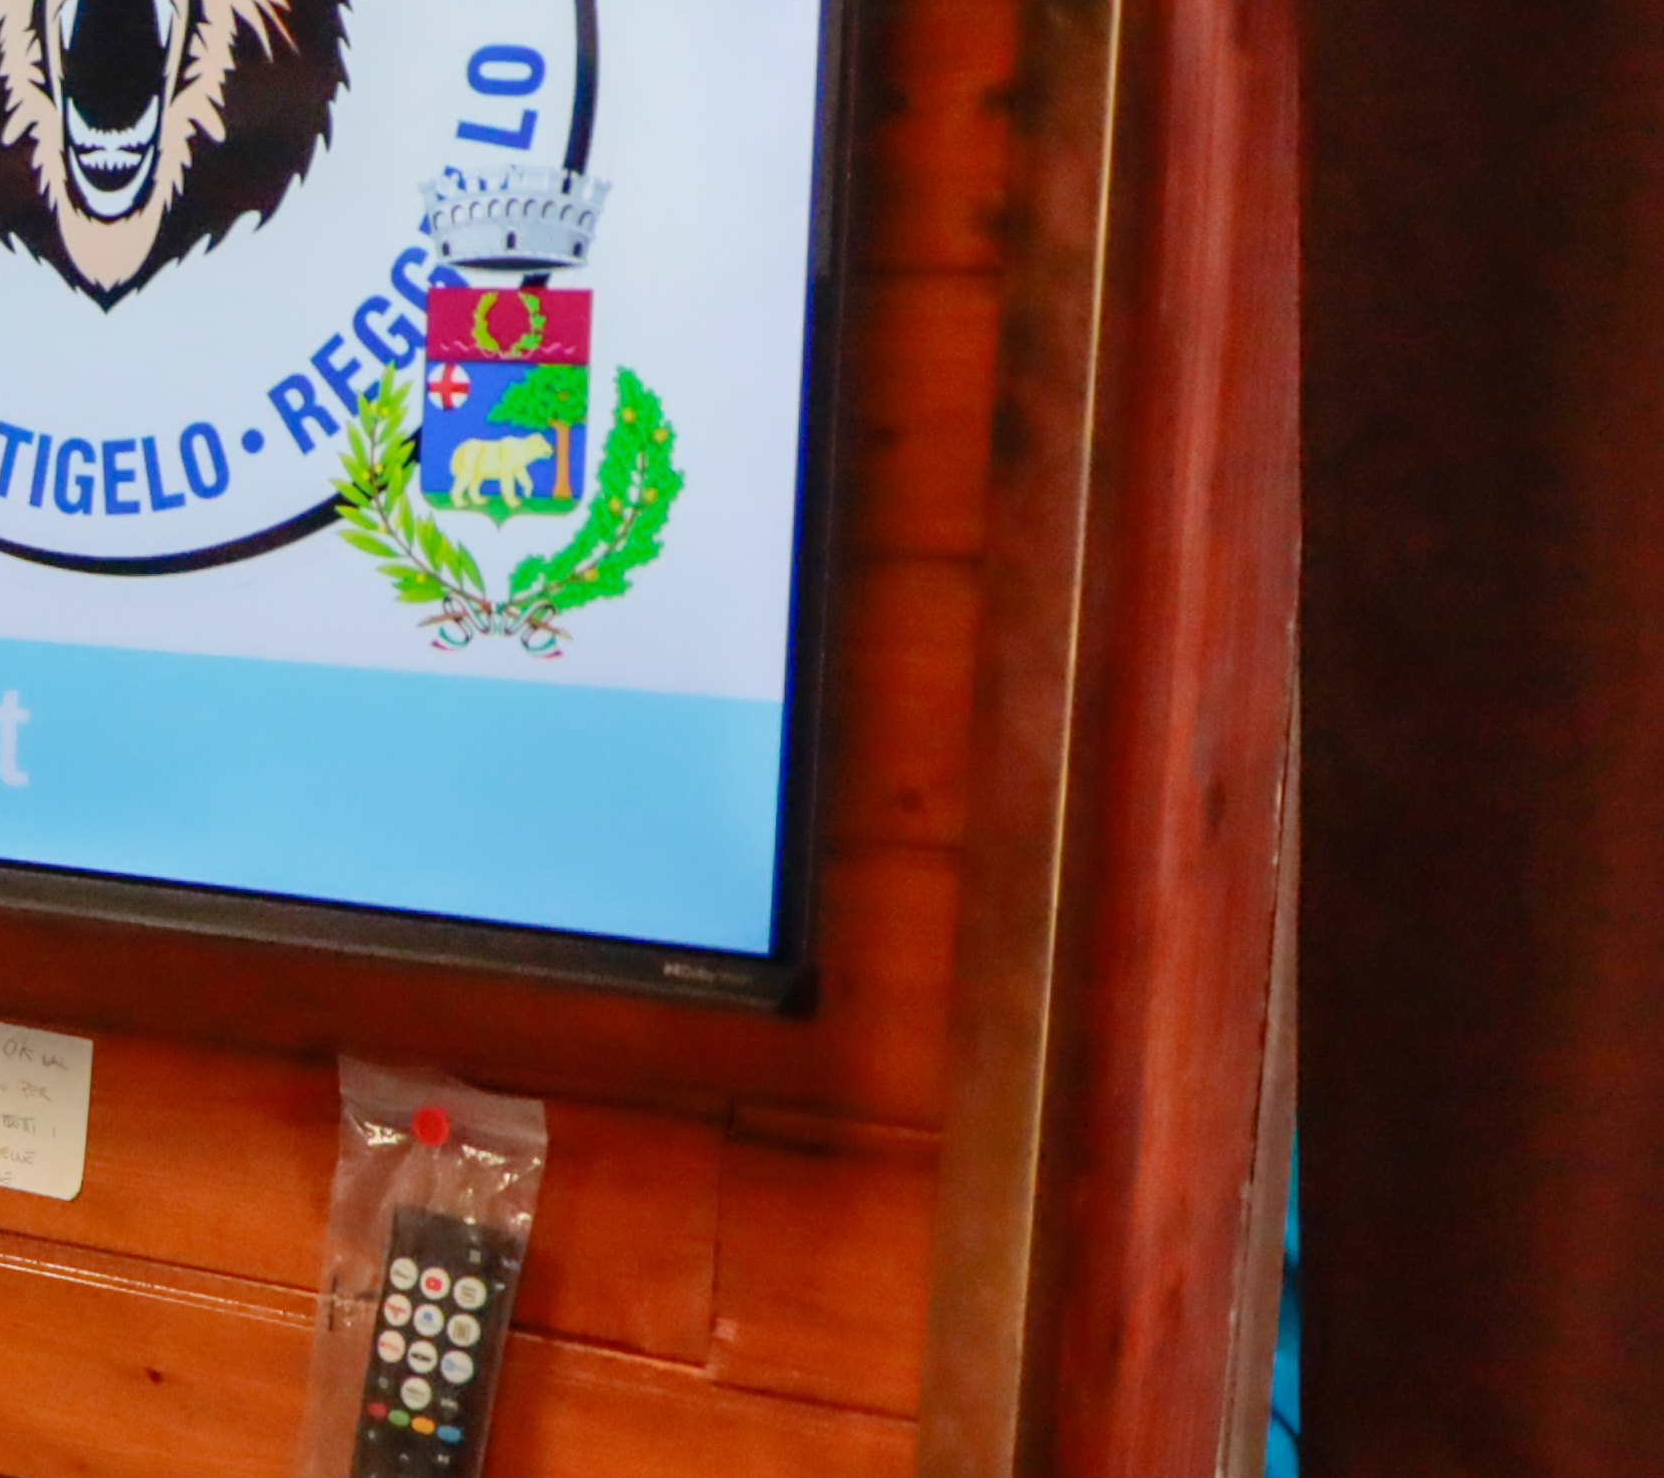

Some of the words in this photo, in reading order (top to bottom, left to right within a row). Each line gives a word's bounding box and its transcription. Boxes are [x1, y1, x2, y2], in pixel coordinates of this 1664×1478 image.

[264, 39, 549, 458] REGGLO
[3, 1040, 34, 1061] OK
[21, 1080, 52, 1102] PER
